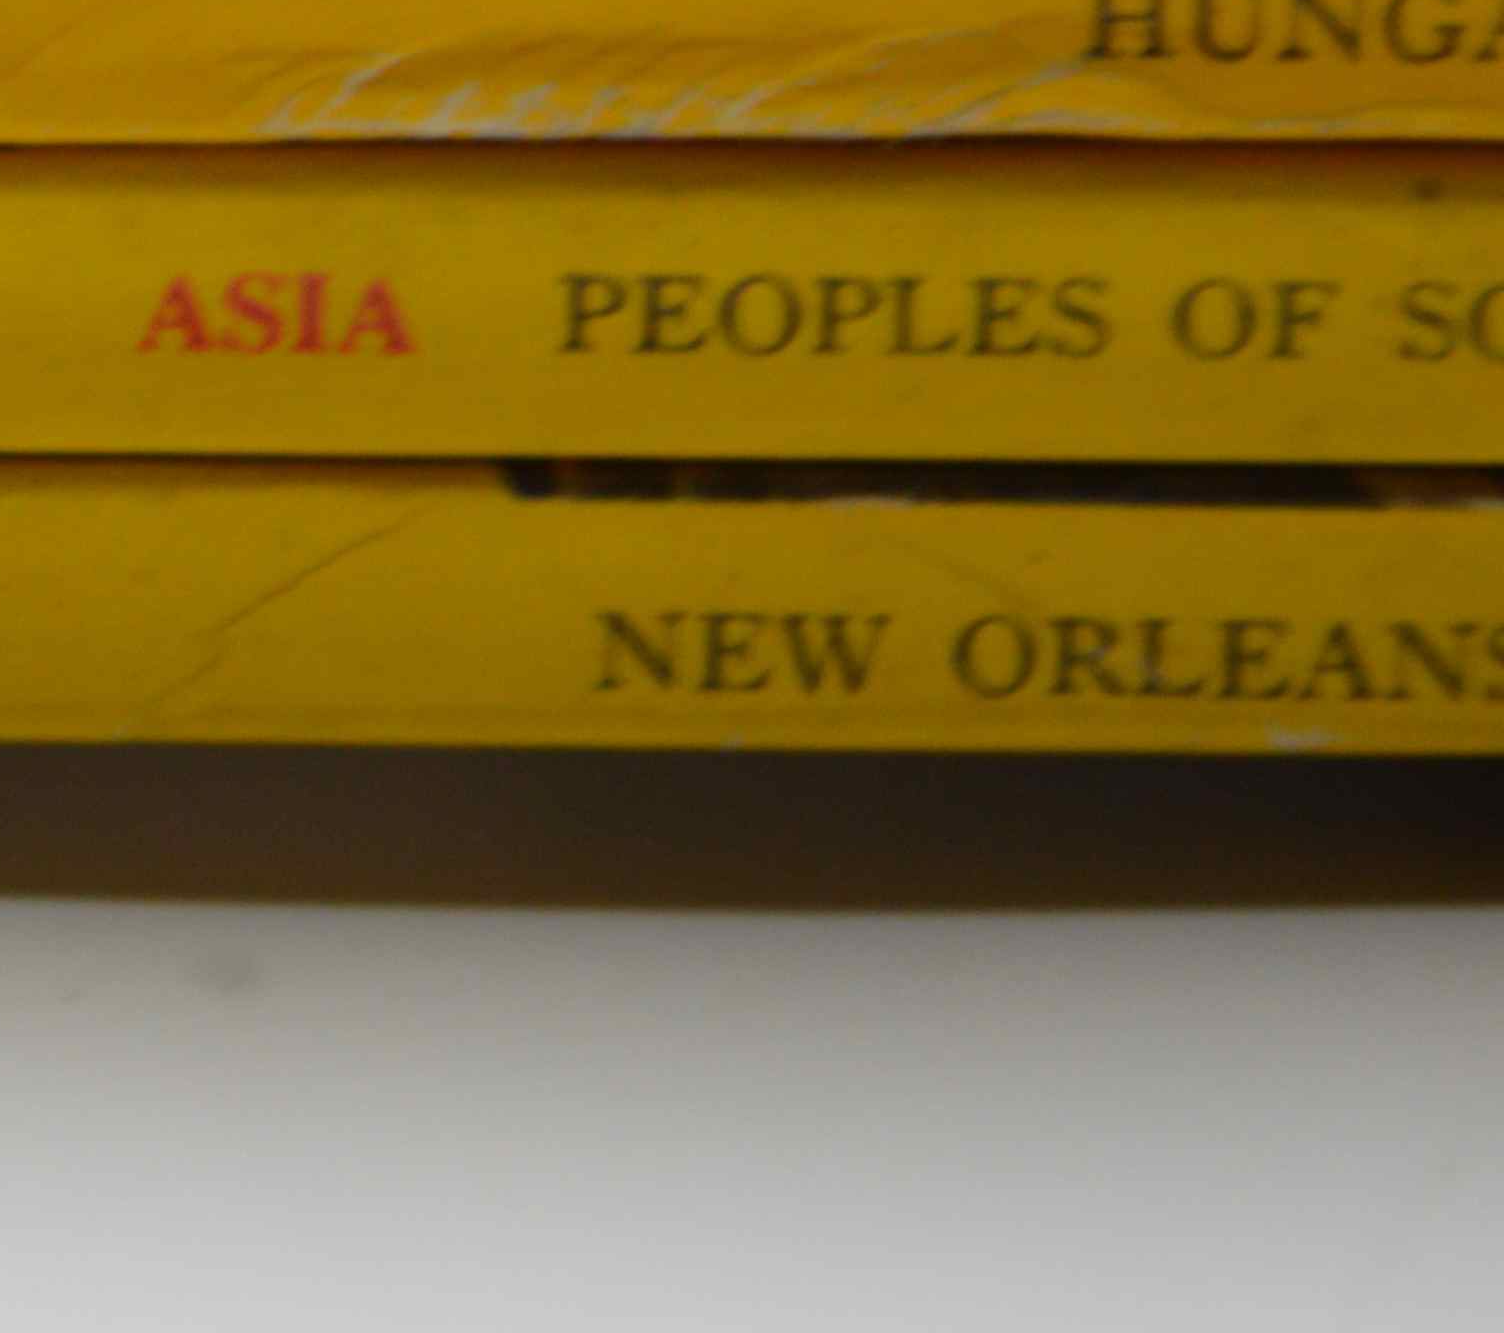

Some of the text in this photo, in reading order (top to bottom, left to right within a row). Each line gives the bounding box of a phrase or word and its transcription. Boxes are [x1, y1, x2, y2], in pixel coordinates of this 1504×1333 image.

[137, 273, 417, 357] ASIA
[560, 274, 1108, 358] PEOPLES
[1171, 276, 1340, 362] OF
[601, 612, 889, 692] NEW
